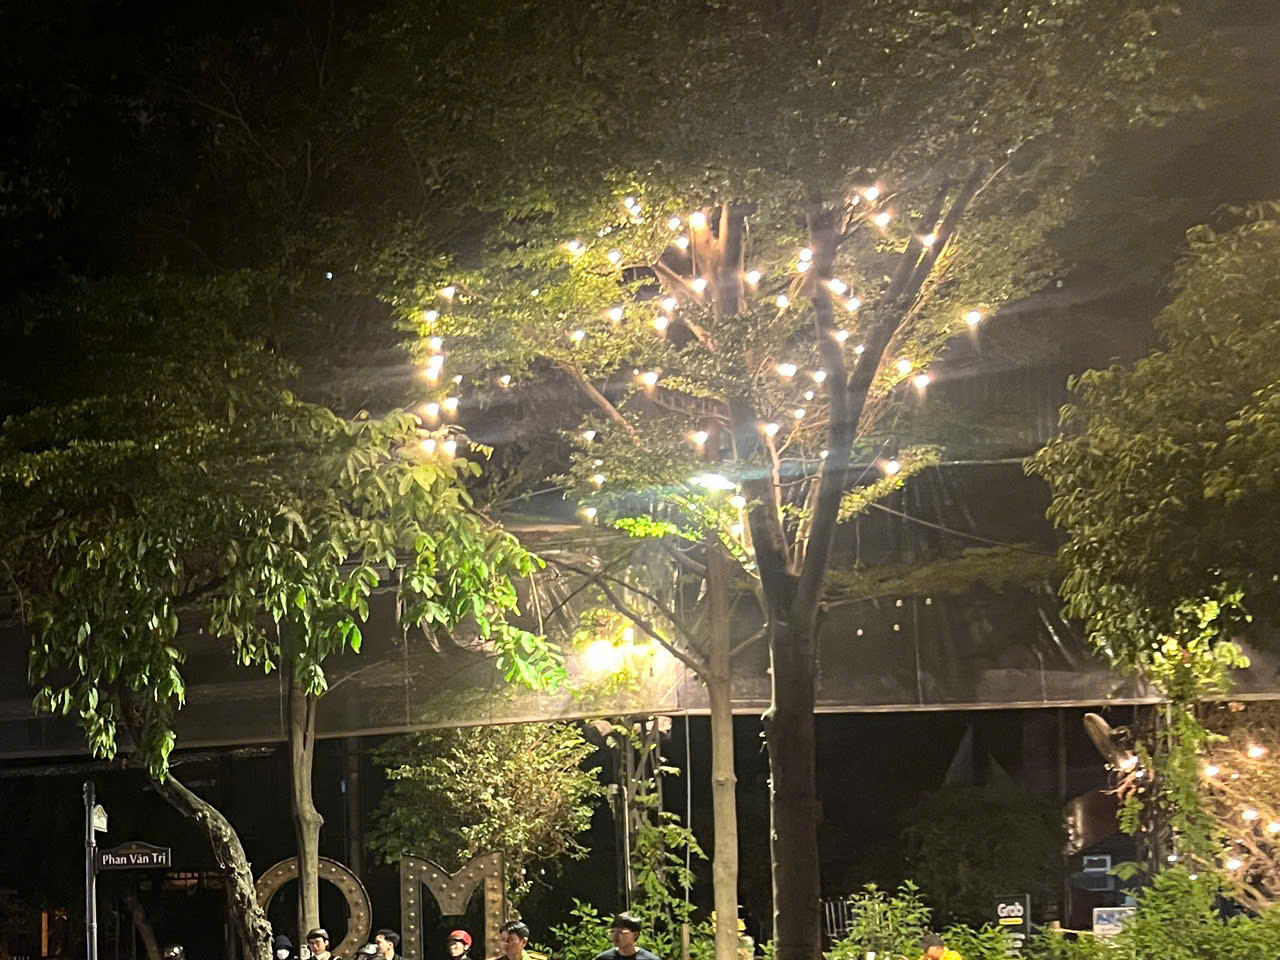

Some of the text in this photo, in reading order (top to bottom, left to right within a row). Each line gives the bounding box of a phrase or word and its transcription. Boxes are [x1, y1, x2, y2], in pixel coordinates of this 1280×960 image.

[102, 854, 127, 865] Phan
[129, 853, 149, 865] Văn
[997, 902, 1024, 917] Grab
